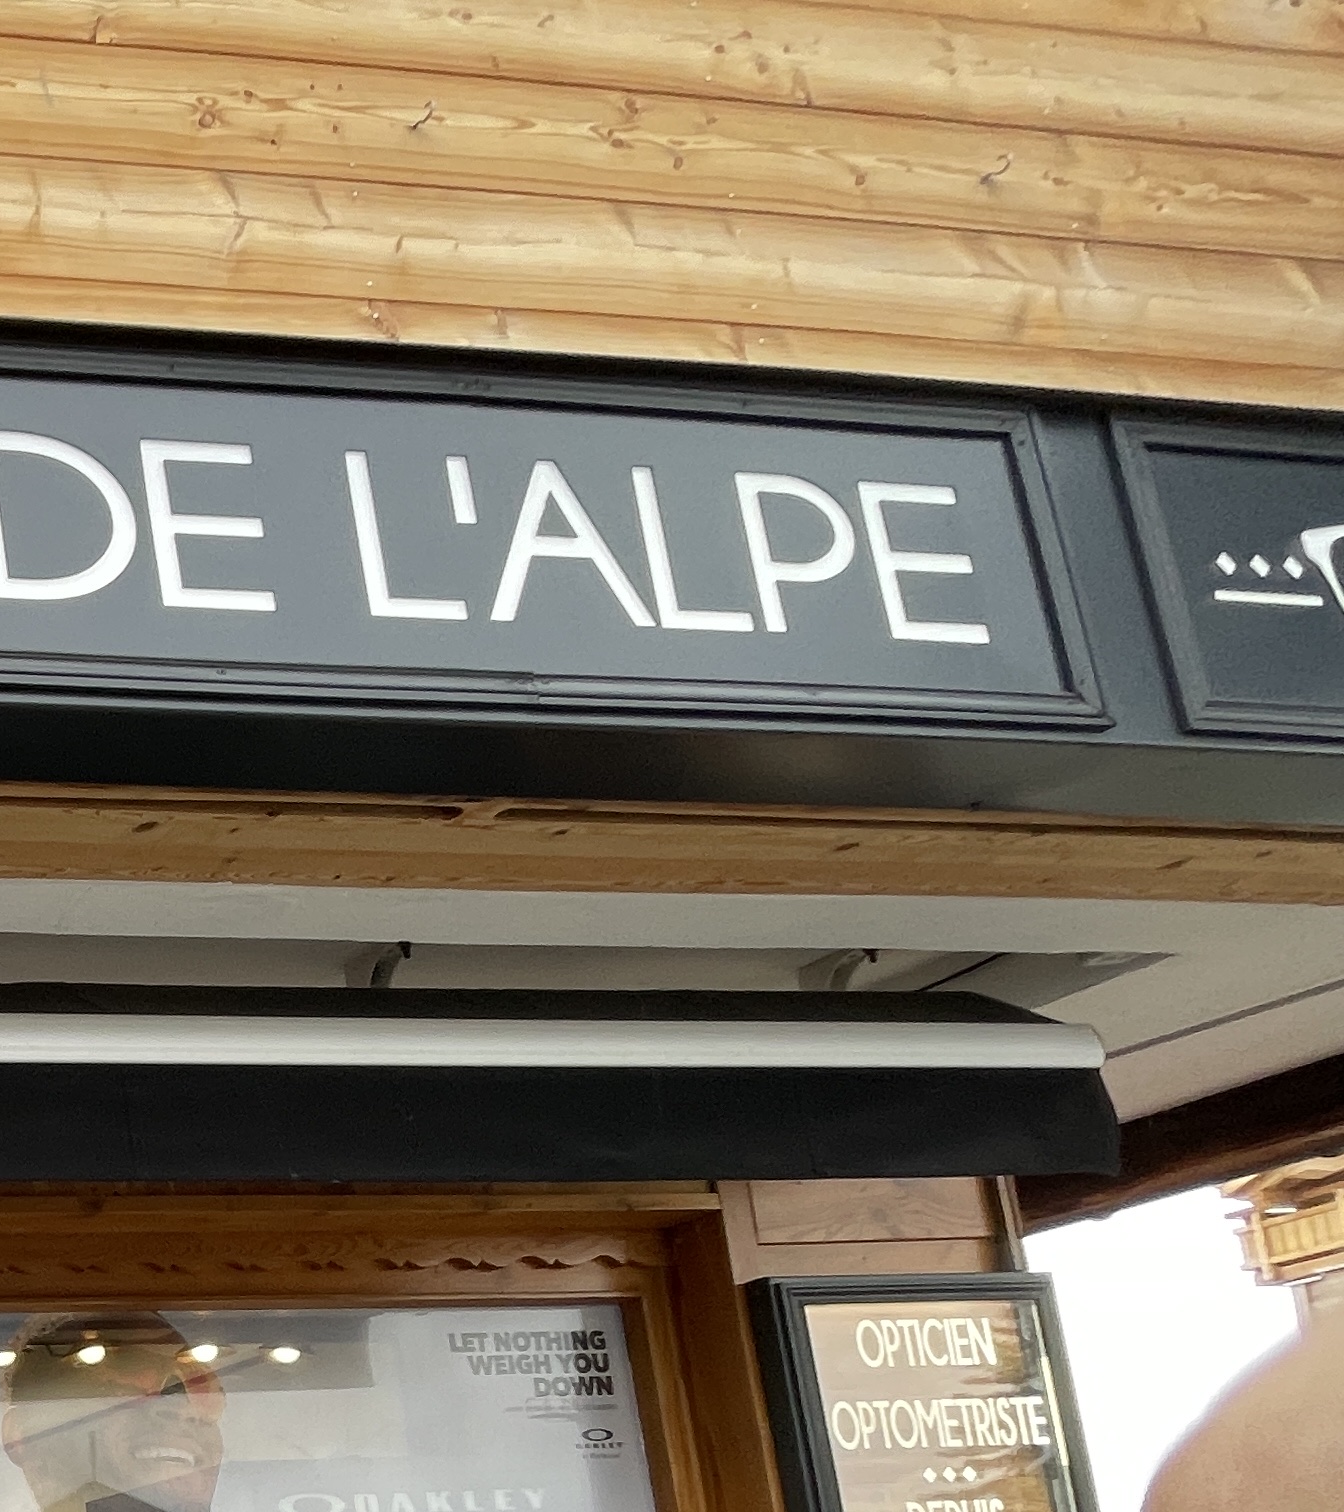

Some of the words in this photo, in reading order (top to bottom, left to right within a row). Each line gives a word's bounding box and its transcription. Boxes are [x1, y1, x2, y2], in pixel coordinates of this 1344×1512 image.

[345, 451, 990, 644] L'ALPE
[447, 1332, 488, 1353] LET
[493, 1330, 607, 1352] NOTHING
[855, 1317, 998, 1368] OPTICIEN
[467, 1354, 552, 1376] WEIGH
[555, 1353, 610, 1374] YOU
[533, 1375, 615, 1397] DOWN
[831, 1396, 1051, 1452] OPTOMETRISTE
